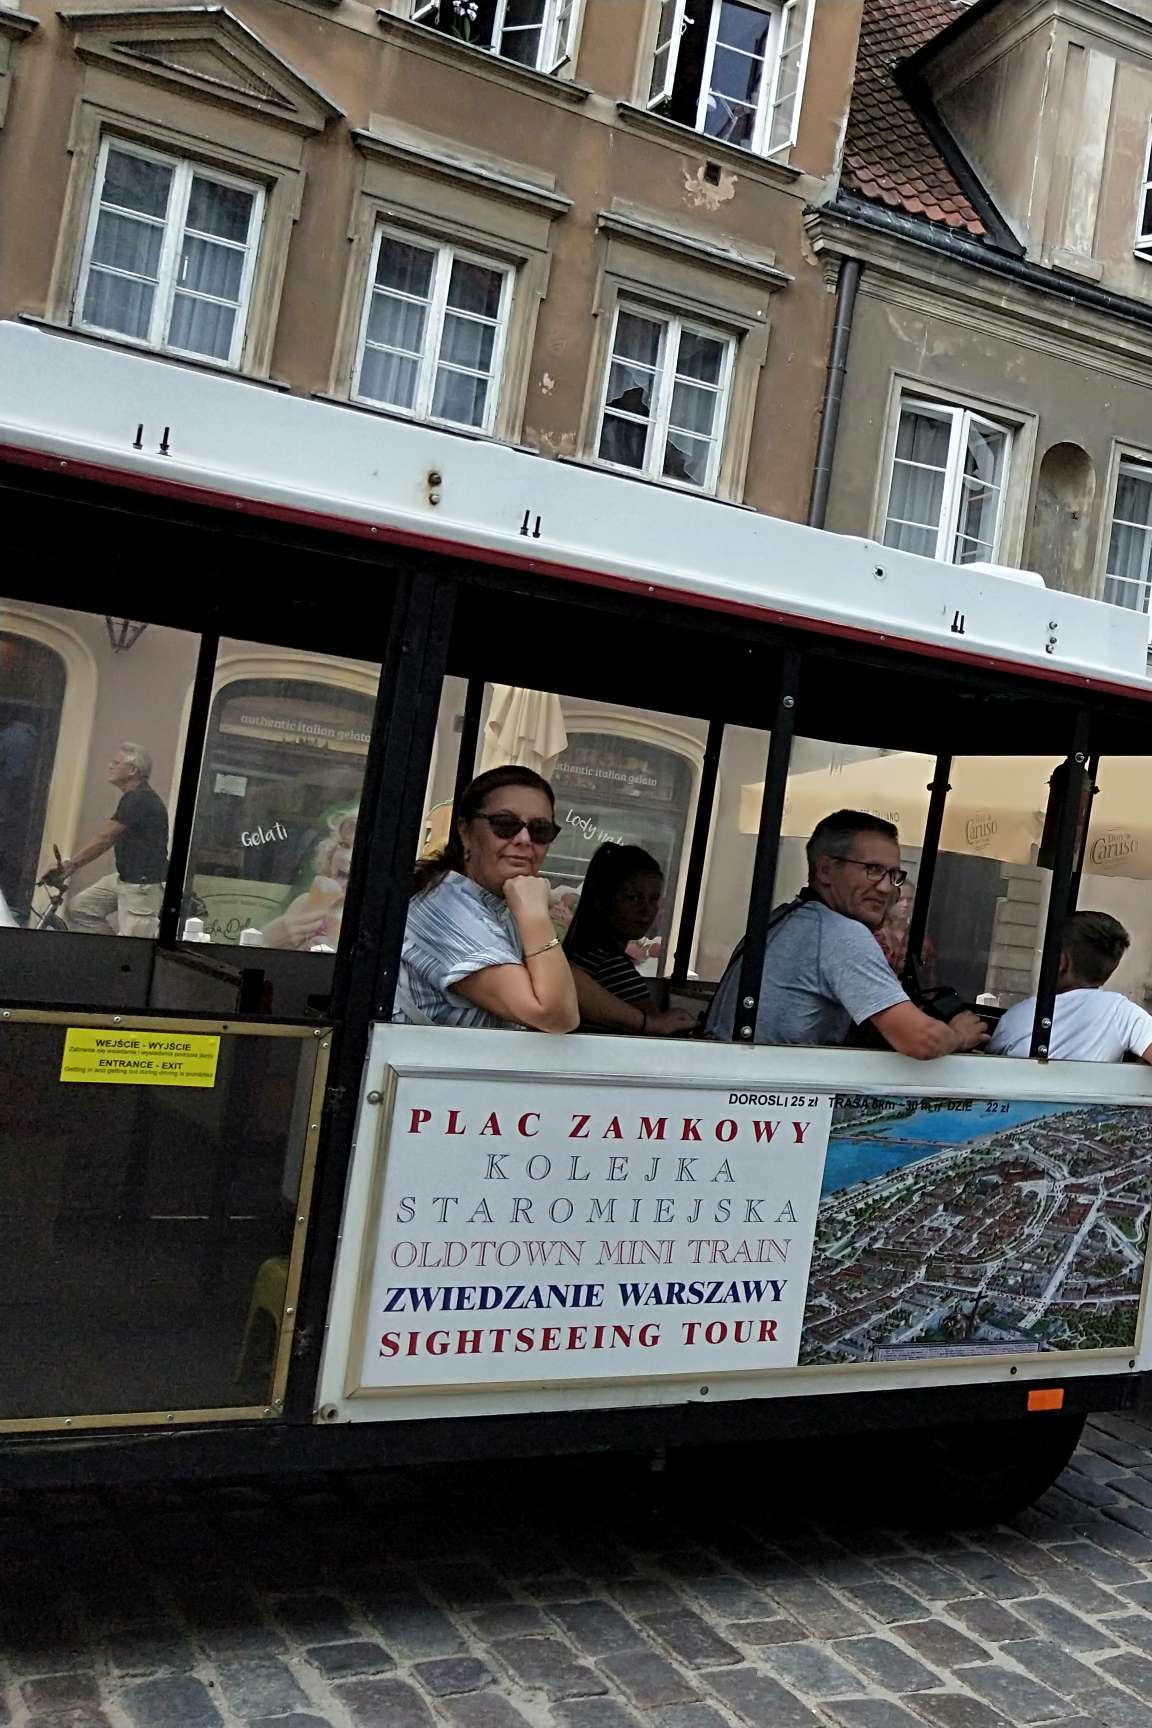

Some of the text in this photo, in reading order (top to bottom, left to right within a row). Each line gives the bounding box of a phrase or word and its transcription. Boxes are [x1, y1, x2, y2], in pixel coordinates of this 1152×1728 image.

[241, 821, 288, 847] Gelati
[565, 808, 597, 840] Lody
[95, 1038, 140, 1049] WEJŚCIE
[148, 1040, 192, 1051] WYJŚCIE
[98, 1059, 153, 1069] ENTRANCE
[161, 1062, 184, 1070] EXIT
[790, 1095, 806, 1108] 25
[828, 1097, 868, 1110] TRASA
[985, 1102, 999, 1113] 22
[408, 1109, 811, 1144] PLAC ZAMKOWY
[484, 1153, 736, 1183] KOLEJKA
[396, 1196, 798, 1224] STAROMIEJSKA
[391, 1238, 792, 1268] OLDTOWN MINI TRAIN
[382, 1279, 787, 1313] ZWIEDZANIE WARSZAWY
[379, 1319, 778, 1358] SIGHTSEEING TOUR
